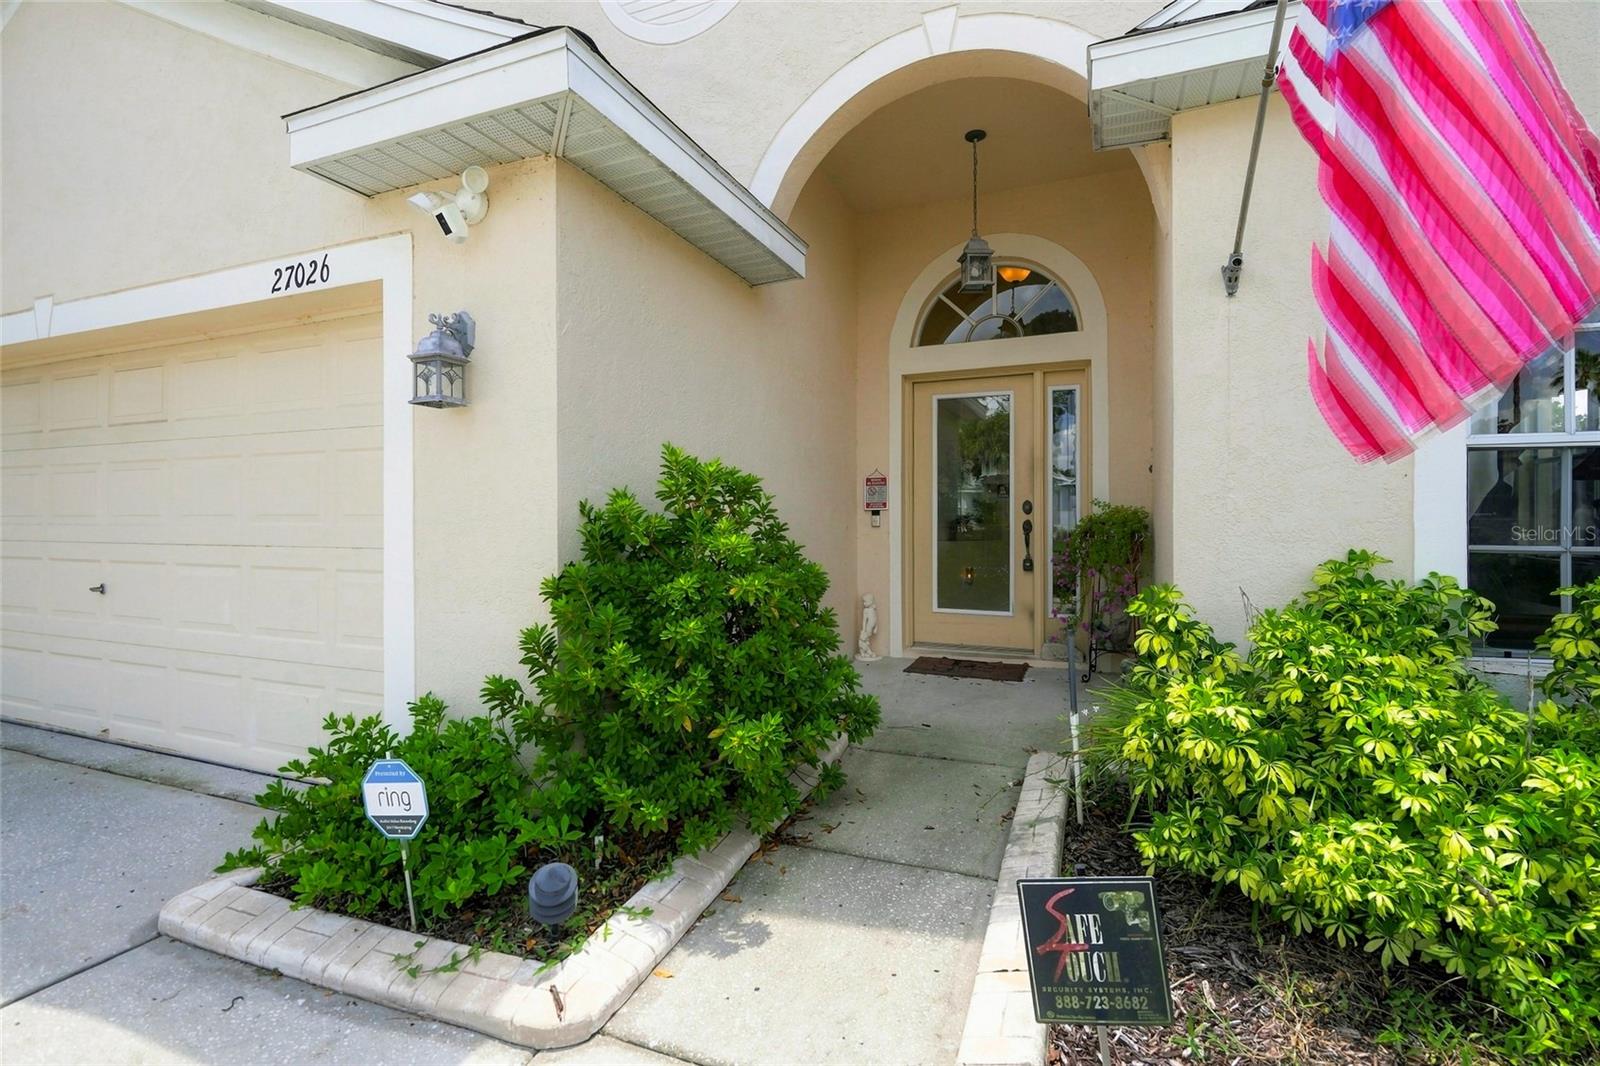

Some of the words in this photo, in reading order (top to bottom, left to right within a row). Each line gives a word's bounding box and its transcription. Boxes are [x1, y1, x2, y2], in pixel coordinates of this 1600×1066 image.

[271, 253, 330, 294] 27026
[378, 787, 411, 812] ring
[1037, 888, 1103, 954] SAFE
[1055, 994, 1149, 1010] 888-723-8682
